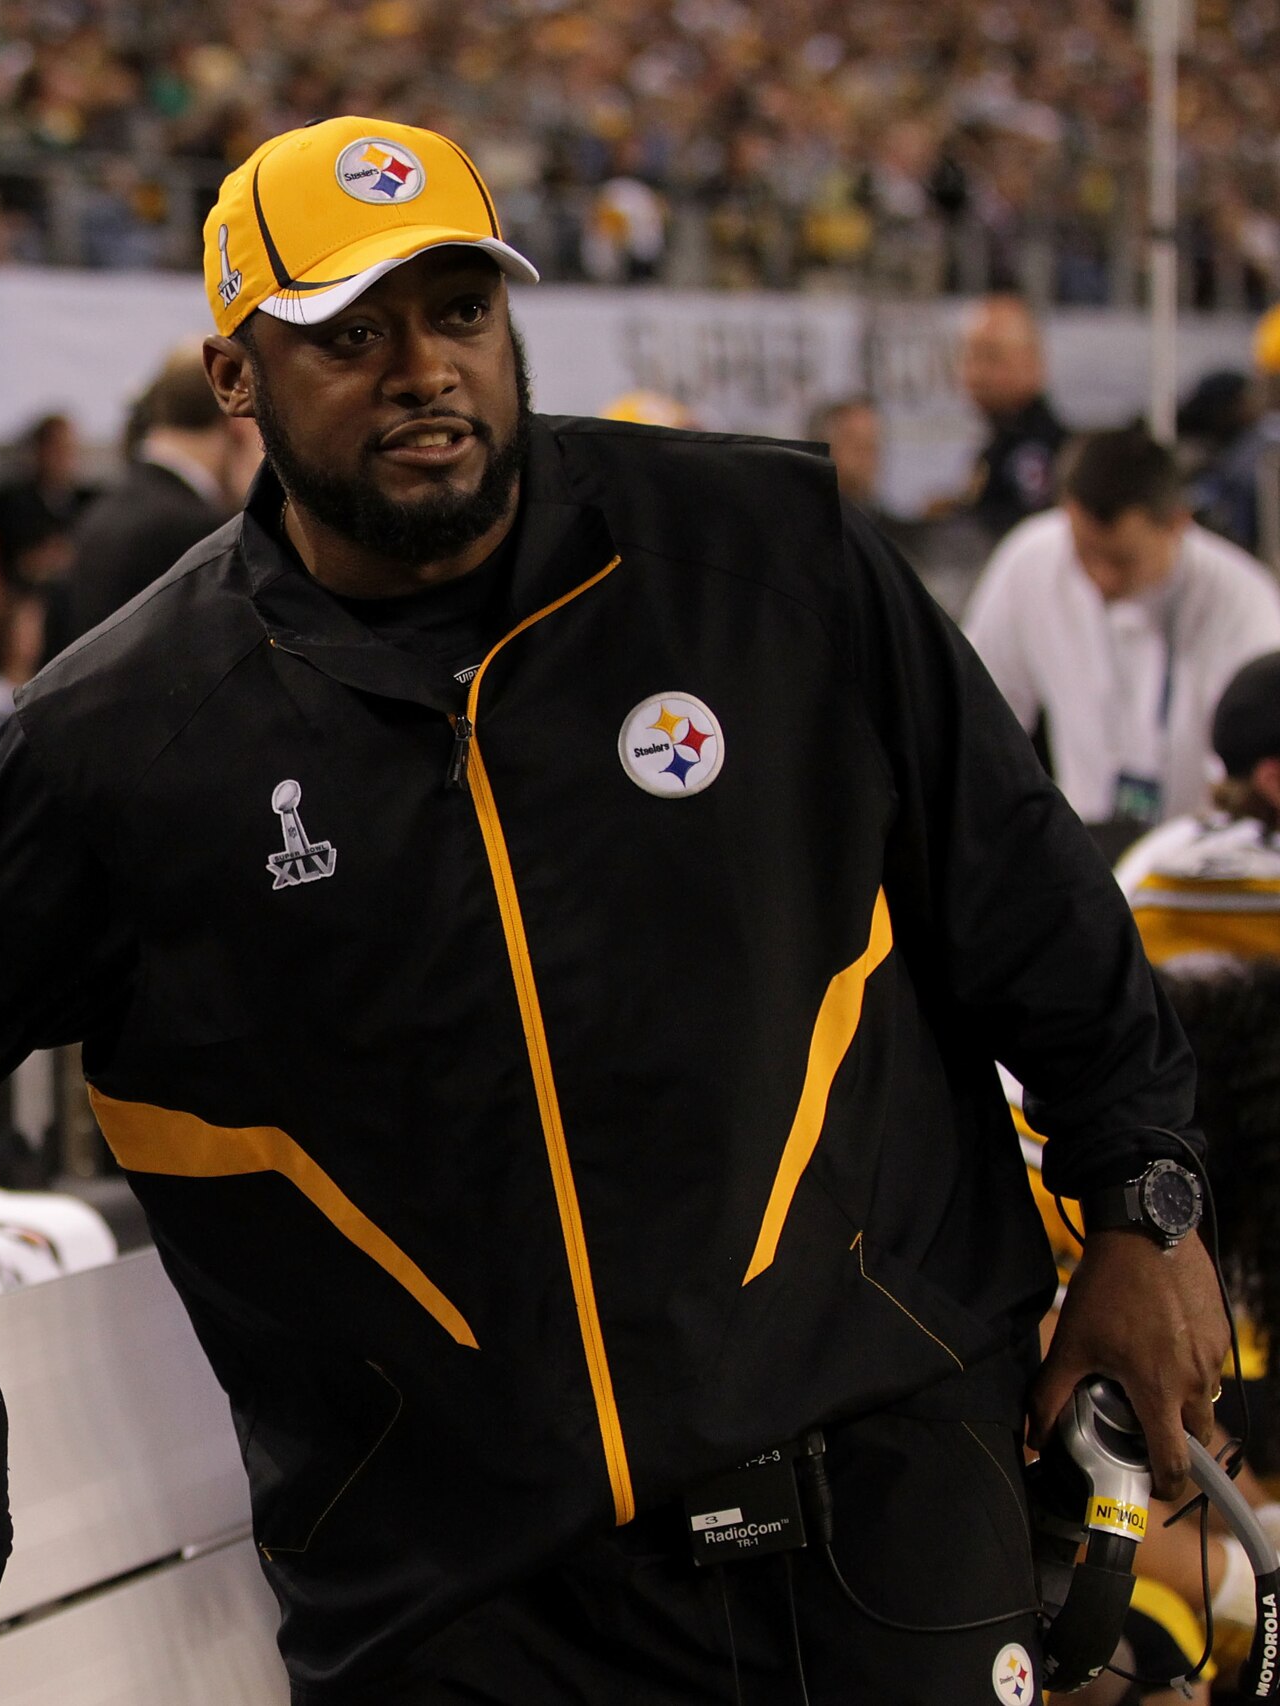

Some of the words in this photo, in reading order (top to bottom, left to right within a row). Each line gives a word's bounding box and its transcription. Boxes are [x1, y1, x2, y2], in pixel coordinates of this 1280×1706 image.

[344, 168, 380, 182] Steelers
[219, 272, 243, 310] XLV
[633, 742, 670, 758] Steelers
[273, 850, 301, 862] SUPER
[304, 844, 327, 855] BOWL
[266, 848, 337, 889] XLV
[704, 1515, 719, 1525] 3
[1096, 1504, 1145, 1530] TOMLIN
[737, 1537, 760, 1549] TR-1
[1255, 1592, 1279, 1697] MOTOROLA
